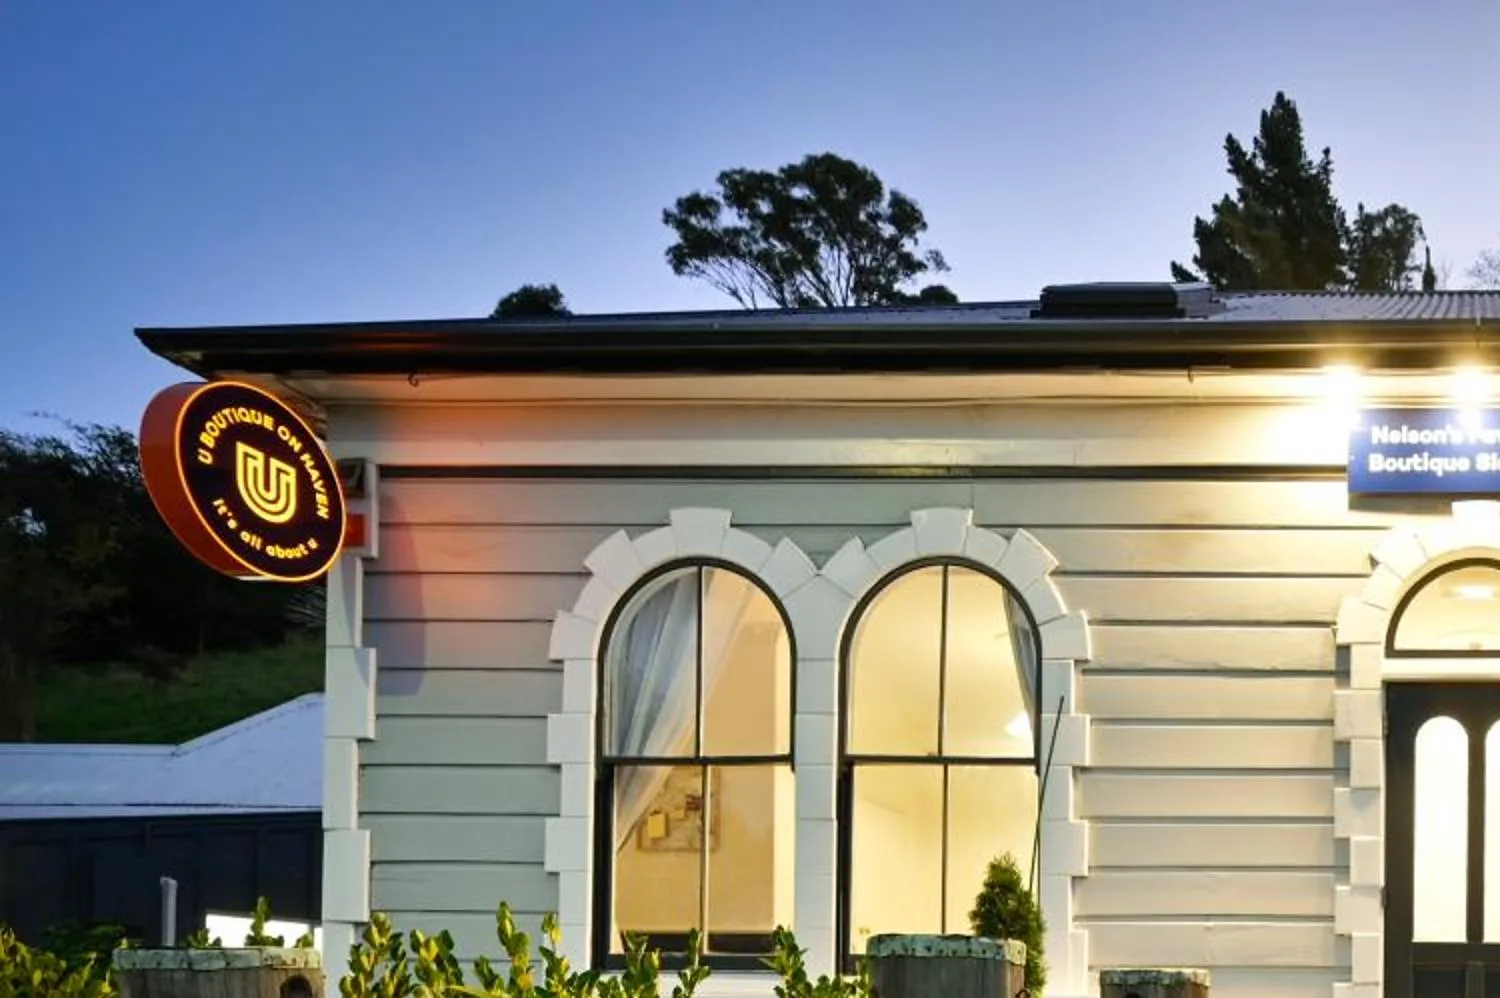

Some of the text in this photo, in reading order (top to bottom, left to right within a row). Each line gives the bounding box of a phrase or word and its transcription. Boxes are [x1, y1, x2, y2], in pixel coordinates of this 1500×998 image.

[198, 407, 330, 519] U BOUTIQUE ON HAVEN
[1368, 452, 1470, 477] Boutique
[212, 498, 238, 530] It's
[240, 530, 263, 551] all
[265, 542, 309, 559] about
